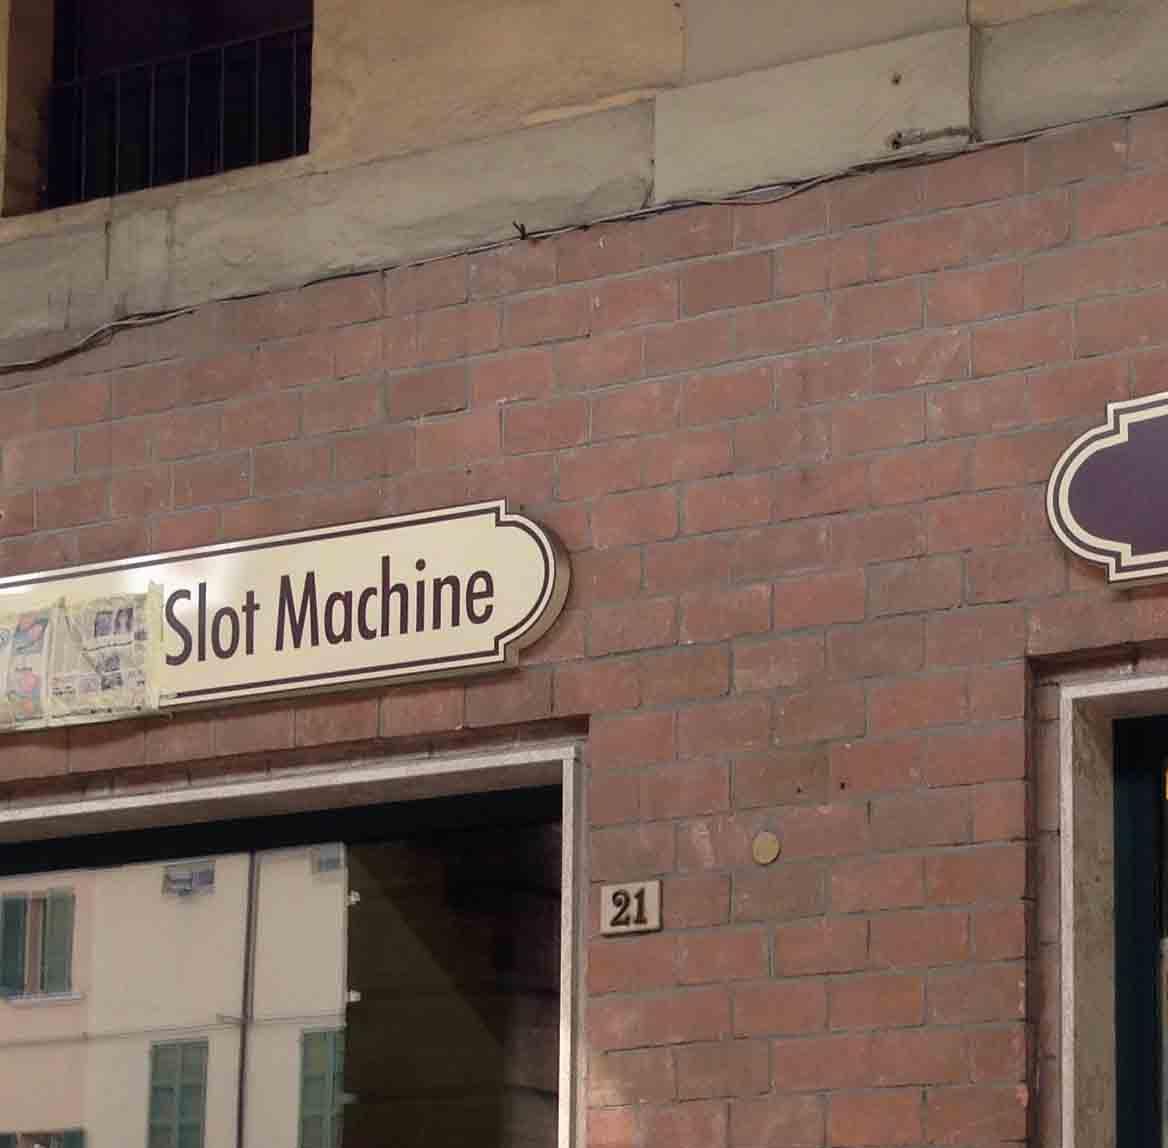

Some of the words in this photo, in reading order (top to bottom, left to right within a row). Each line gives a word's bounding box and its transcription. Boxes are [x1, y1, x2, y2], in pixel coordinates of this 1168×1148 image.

[164, 583, 261, 666] Slot
[274, 555, 495, 651] Machine
[609, 887, 648, 927] 21
